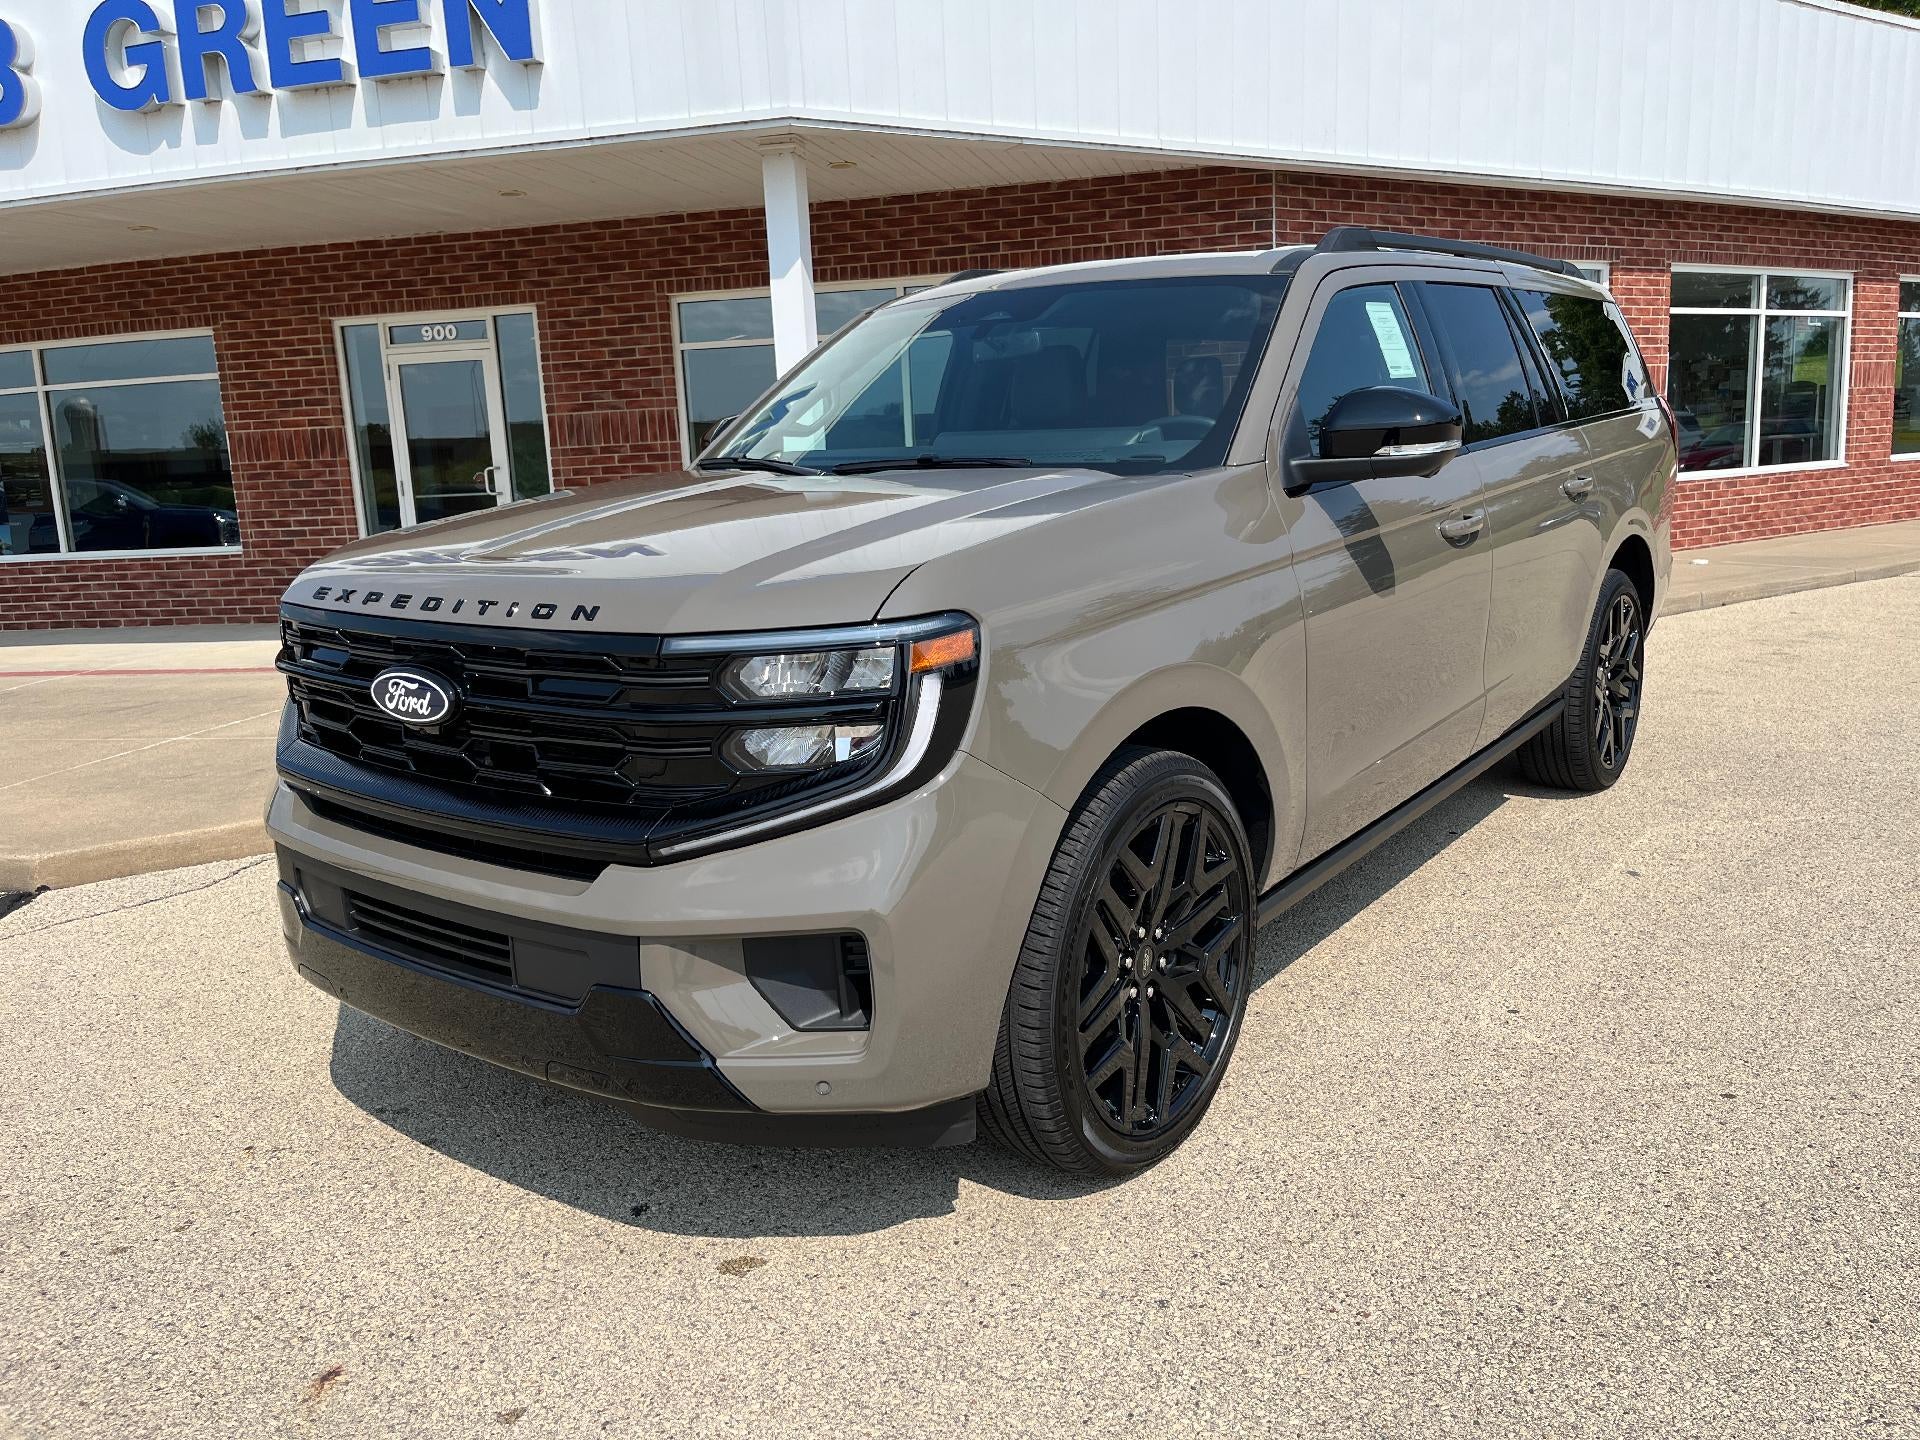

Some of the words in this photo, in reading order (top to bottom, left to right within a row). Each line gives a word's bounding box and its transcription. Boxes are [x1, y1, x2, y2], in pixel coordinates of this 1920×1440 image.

[82, 0, 541, 112] GREEN
[421, 324, 457, 341] 900
[312, 586, 601, 622] EXPEDITION
[384, 678, 432, 716] Ford
